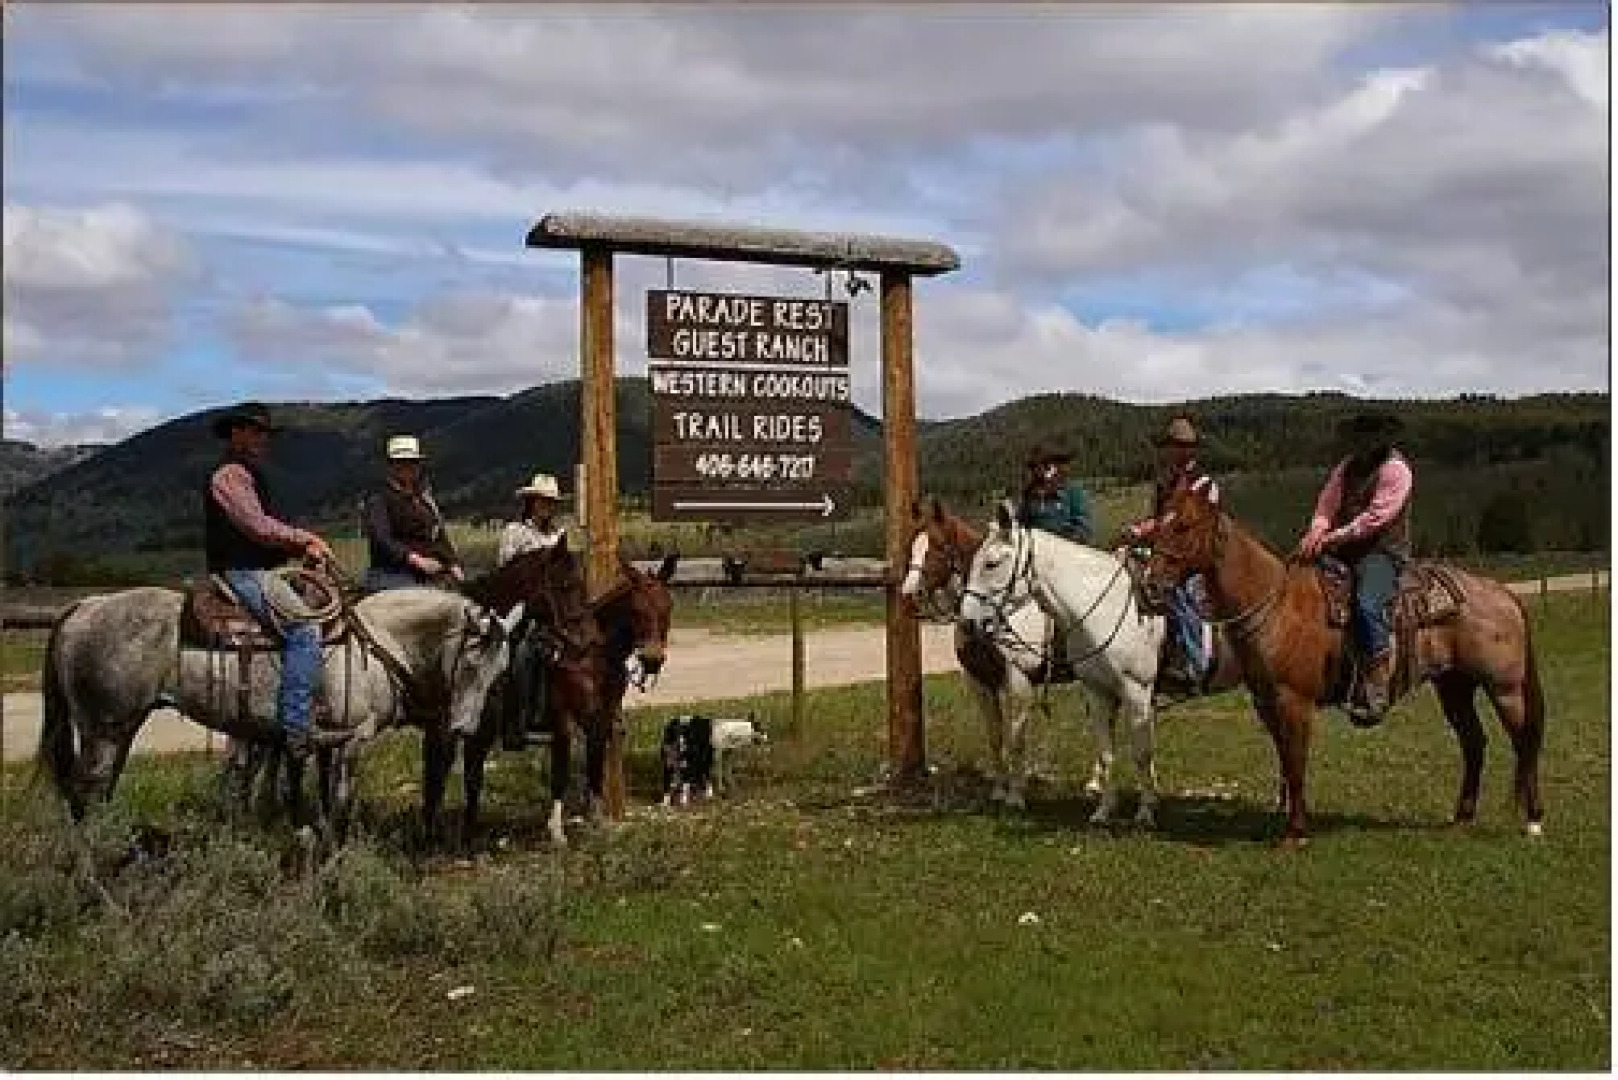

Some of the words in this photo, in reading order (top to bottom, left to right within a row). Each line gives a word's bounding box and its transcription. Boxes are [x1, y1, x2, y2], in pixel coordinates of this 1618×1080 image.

[667, 293, 764, 326] PARADE
[773, 302, 832, 329] REST
[673, 329, 748, 358] GUEST
[757, 334, 829, 361] RANCH
[654, 371, 745, 394] WESTERN
[754, 373, 849, 400] COOKOUTS
[673, 412, 742, 439] TRAIL
[754, 415, 823, 442] RIDES
